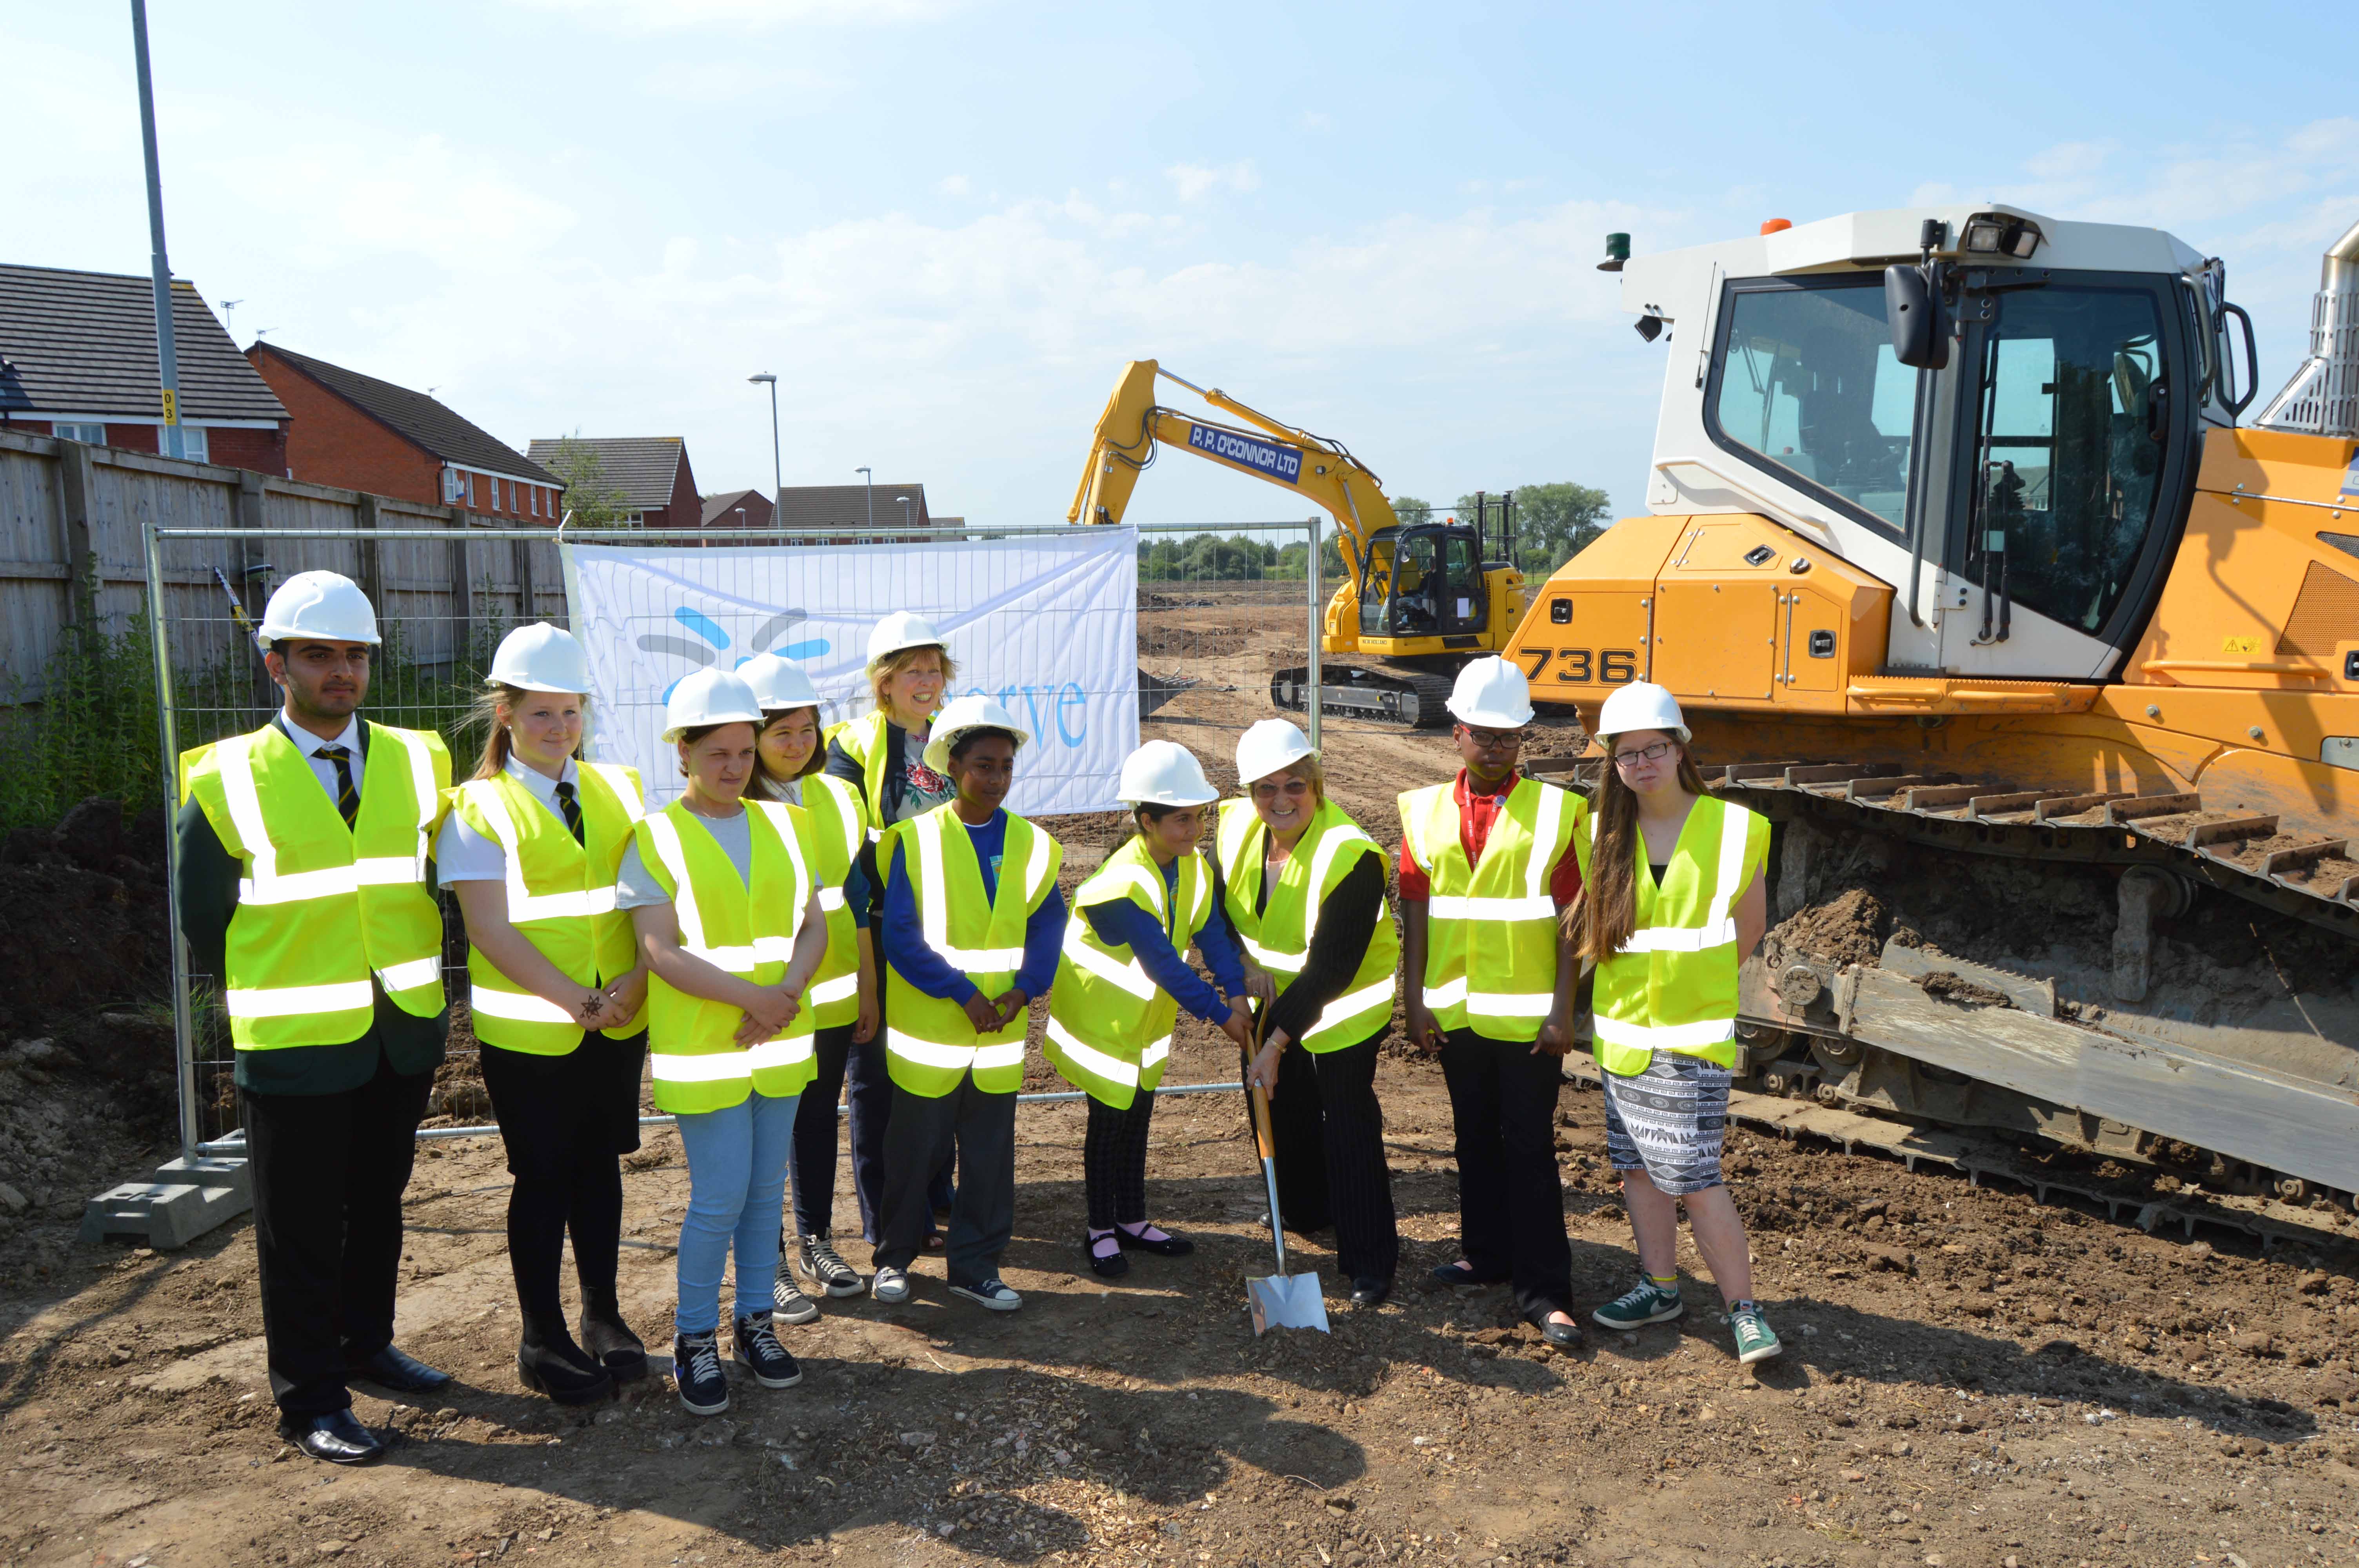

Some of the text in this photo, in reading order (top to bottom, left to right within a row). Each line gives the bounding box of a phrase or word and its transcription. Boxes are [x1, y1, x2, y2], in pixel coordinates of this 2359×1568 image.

[1192, 427, 1298, 475] P. P. O'CONNOR LTD
[1519, 647, 1637, 685] 736
